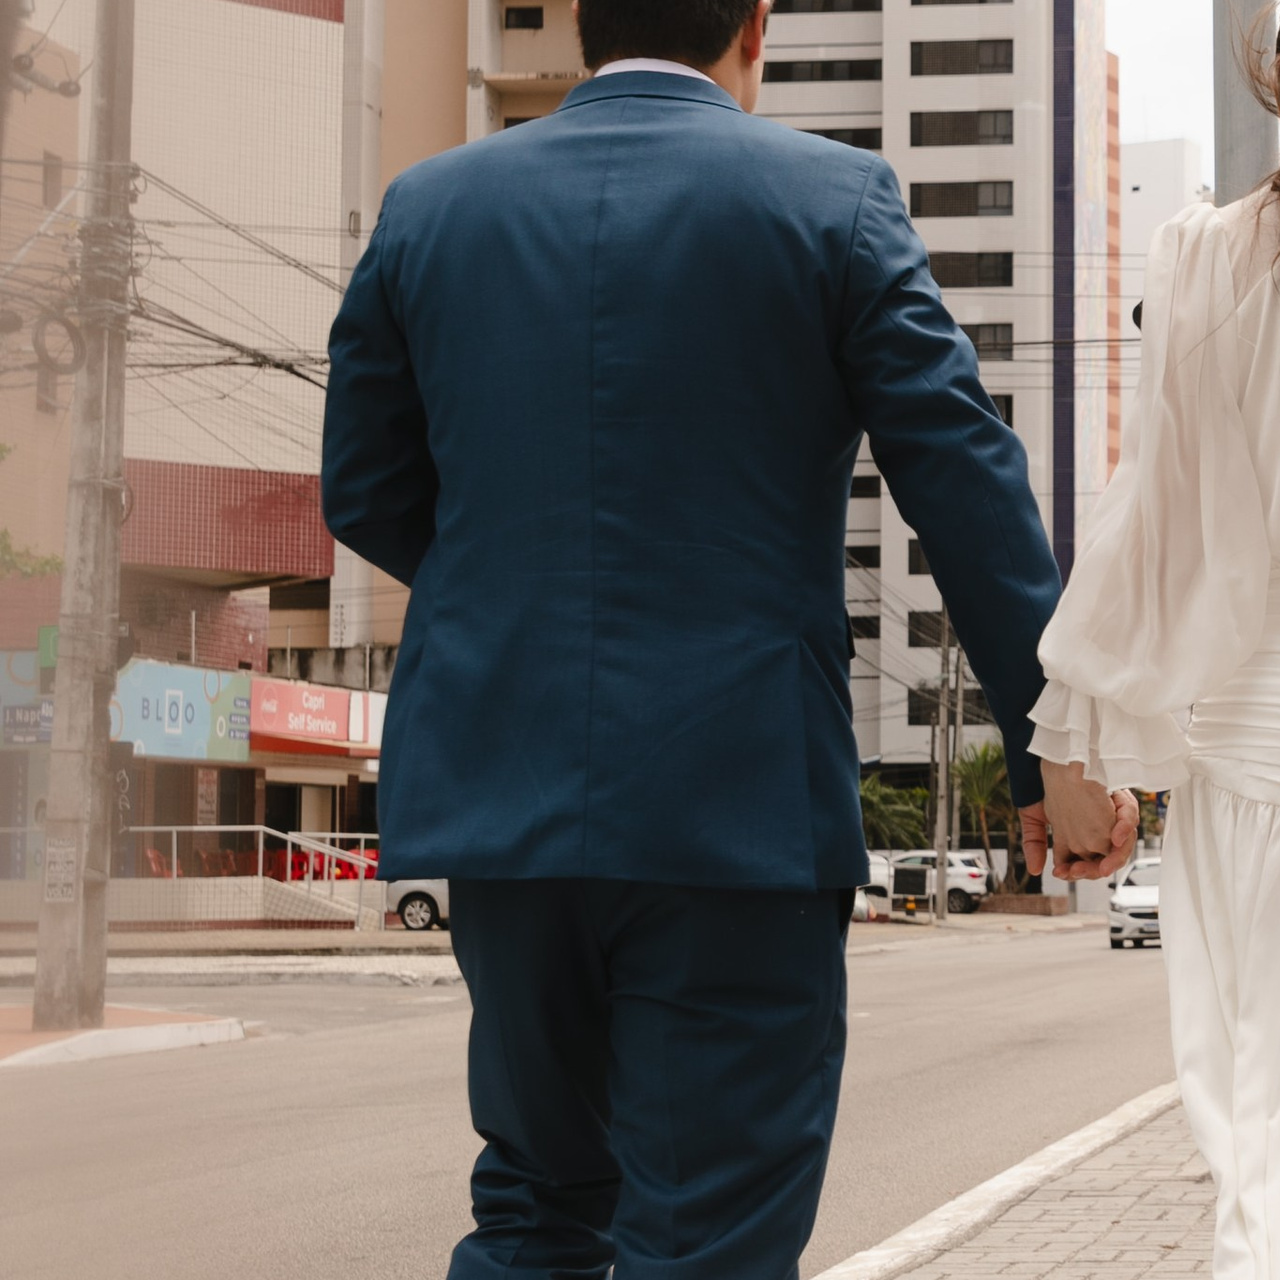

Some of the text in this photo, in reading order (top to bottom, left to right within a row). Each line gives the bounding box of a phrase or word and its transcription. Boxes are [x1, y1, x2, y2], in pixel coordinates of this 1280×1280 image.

[141, 697, 195, 724] BLOO
[302, 691, 325, 712] Capri
[287, 712, 337, 735] Self Service
[47, 883, 74, 898] VOLTA
